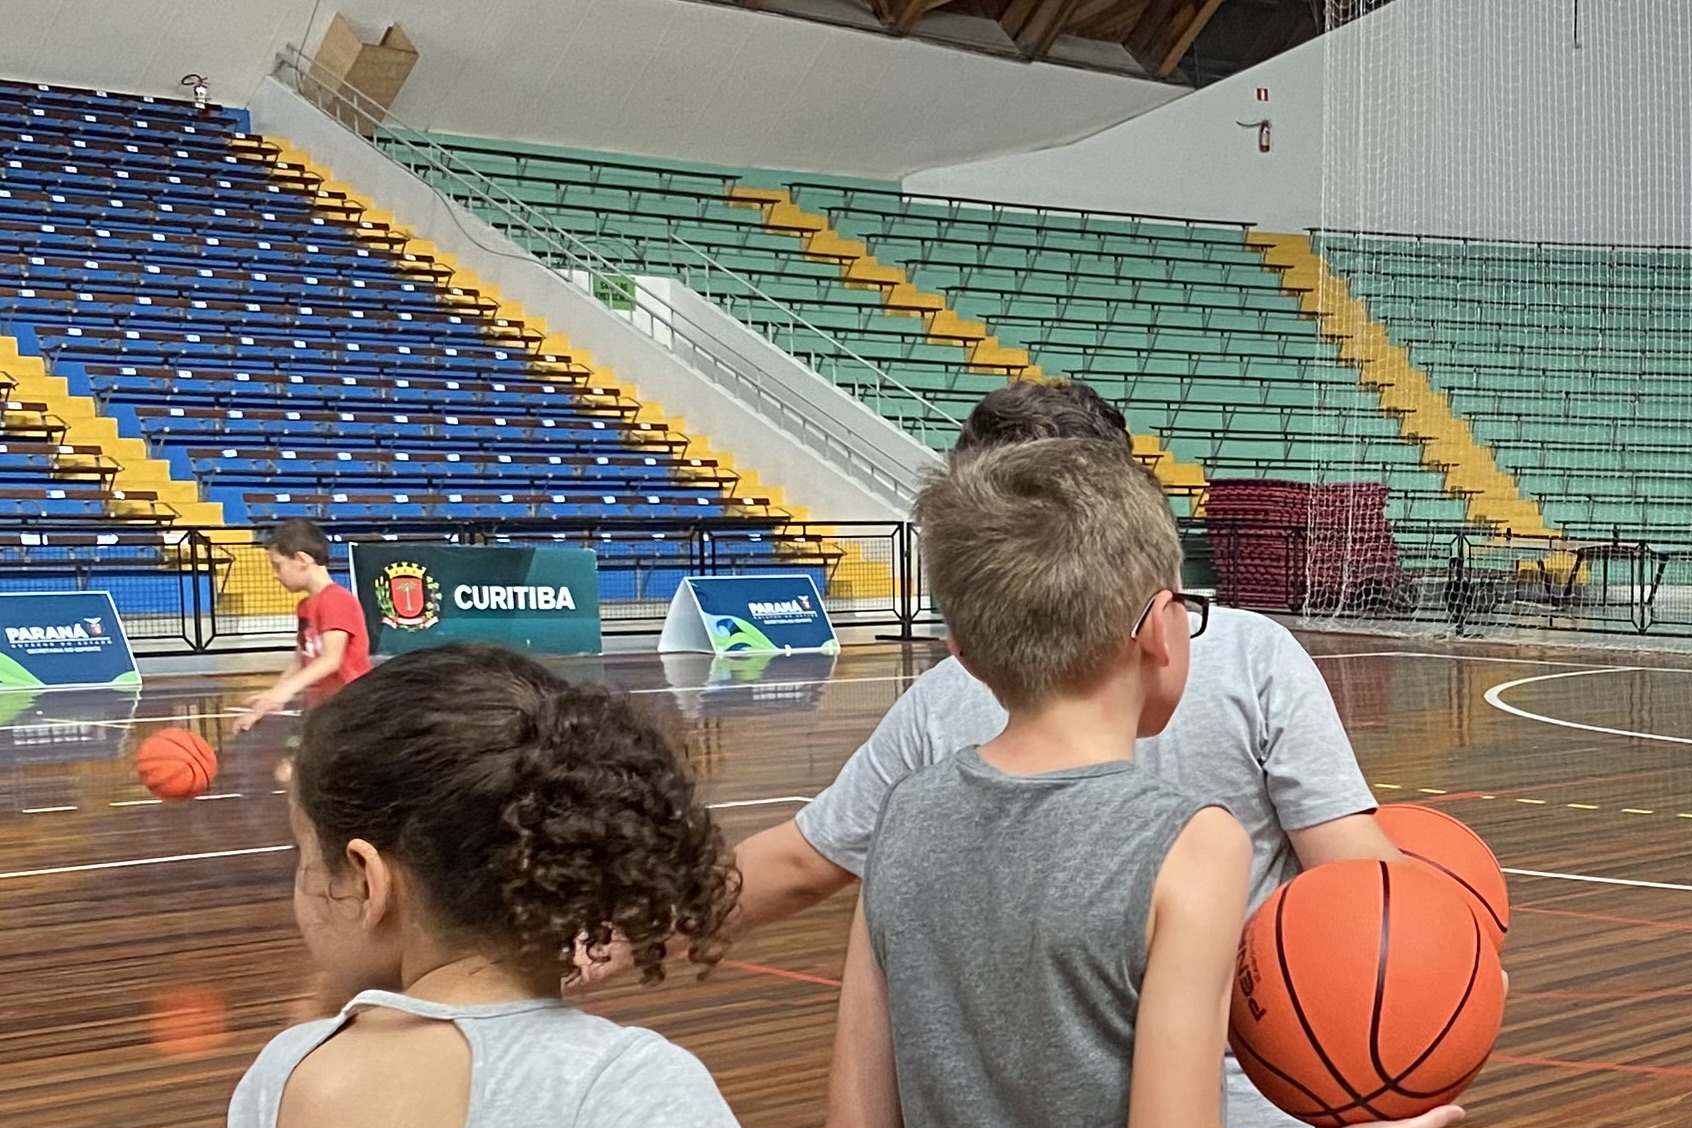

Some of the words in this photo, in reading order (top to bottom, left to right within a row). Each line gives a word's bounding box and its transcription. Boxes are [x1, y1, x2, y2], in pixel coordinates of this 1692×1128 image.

[454, 584, 576, 610] CURITIBA
[747, 599, 803, 615] PARANÁ
[5, 622, 89, 642] PARANÁ
